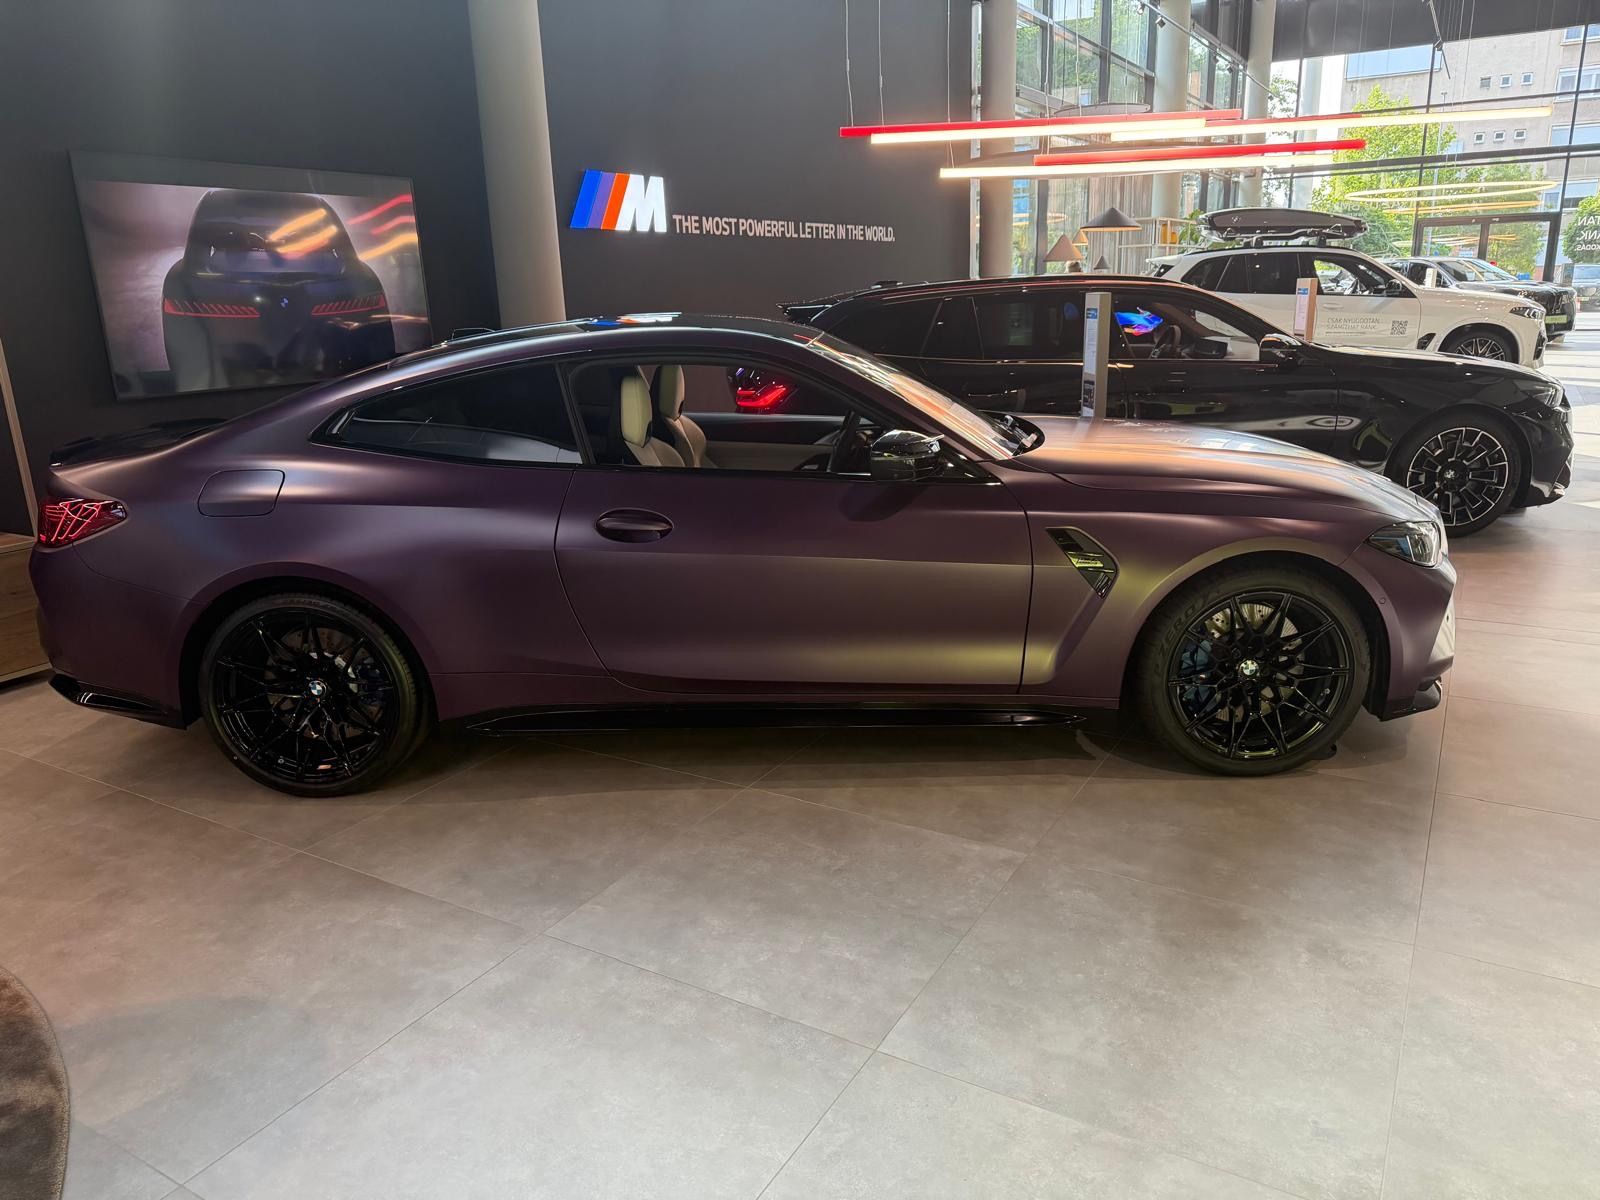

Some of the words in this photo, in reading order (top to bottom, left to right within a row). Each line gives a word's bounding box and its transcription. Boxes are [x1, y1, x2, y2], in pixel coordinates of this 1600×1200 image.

[672, 214, 700, 234] THE
[702, 216, 737, 236] MOST
[738, 218, 798, 238] POWERFUL
[800, 221, 836, 240] LETTER
[836, 223, 846, 240] IN
[847, 224, 864, 241] THE
[865, 225, 896, 242] WORLD.
